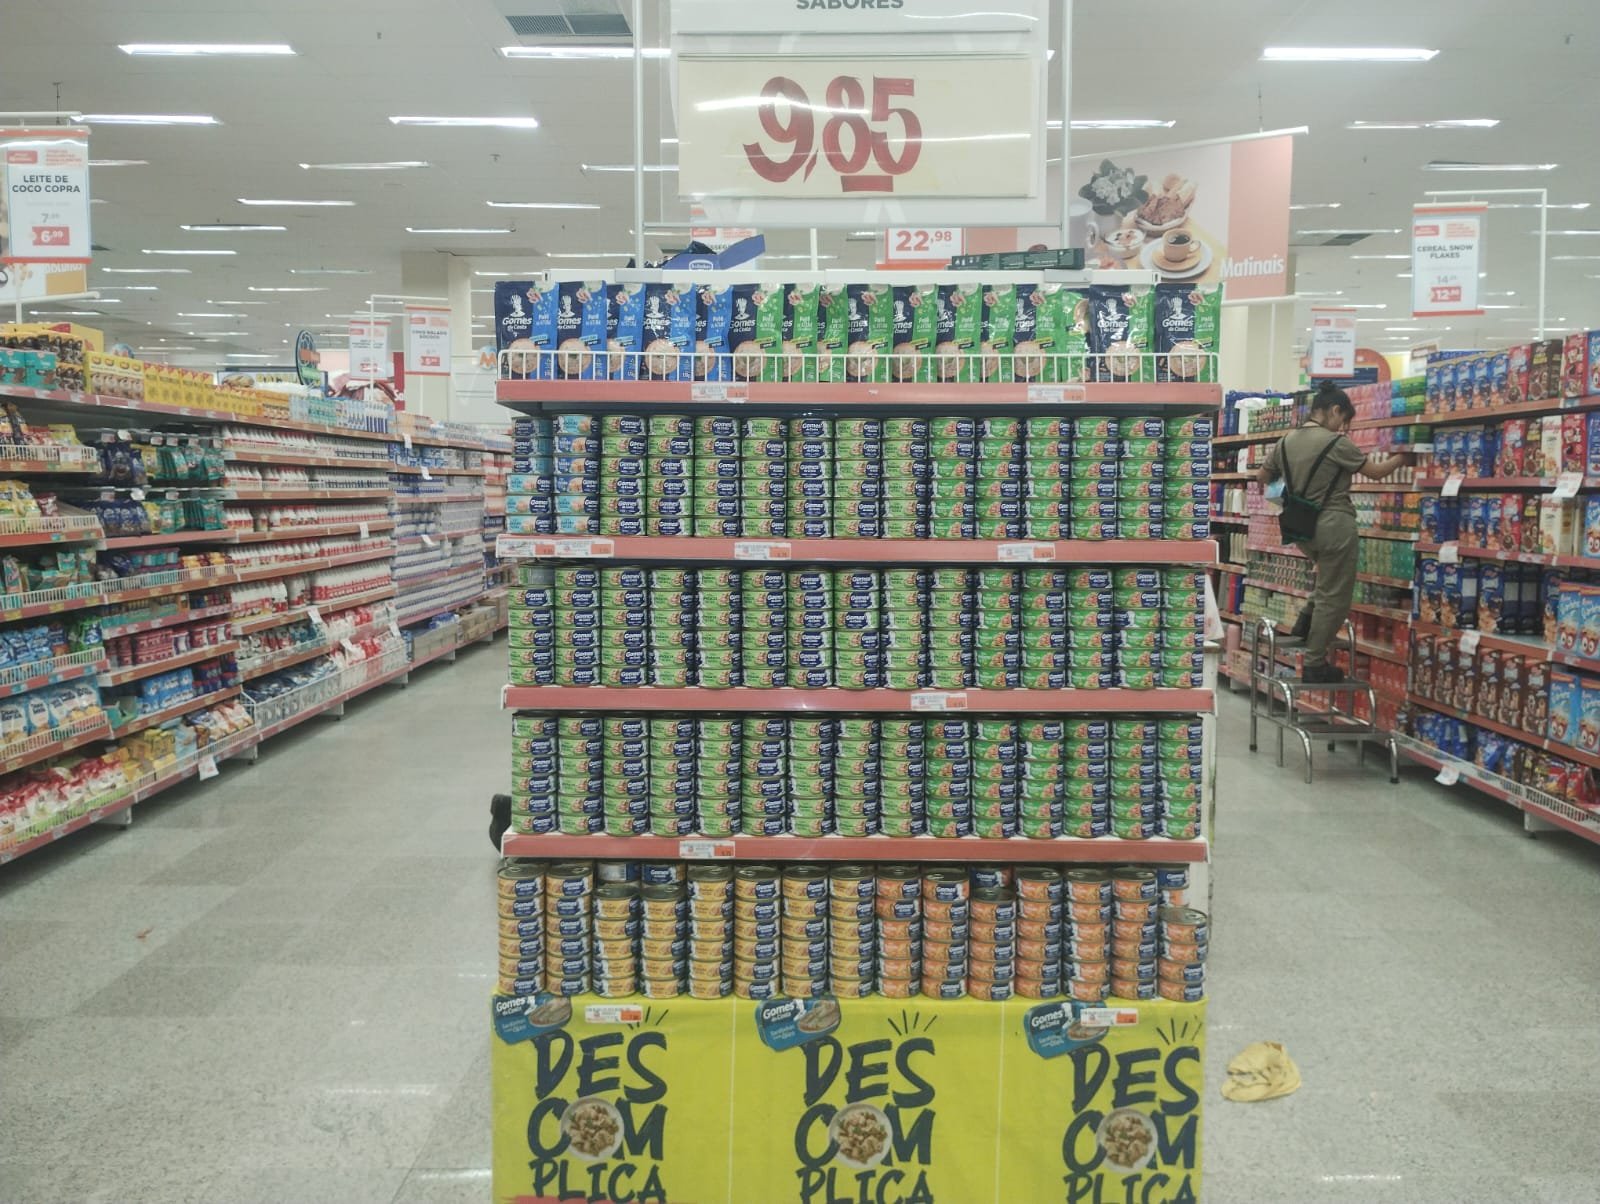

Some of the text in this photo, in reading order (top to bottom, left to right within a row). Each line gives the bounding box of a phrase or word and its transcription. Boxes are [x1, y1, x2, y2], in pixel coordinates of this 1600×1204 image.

[743, 75, 922, 184] 9,85
[12, 184, 81, 193] COCO COPRA
[23, 175, 69, 183] LEITE DE
[895, 230, 952, 252] 22,98
[1417, 245, 1447, 253] CEREAL
[1220, 253, 1285, 278] Matinais
[502, 317, 533, 326] Gomes
[1162, 318, 1194, 327] Gomes
[496, 997, 526, 1012] Gomes
[763, 1002, 795, 1020] Gomes
[1031, 1009, 1064, 1027] Gomes
[530, 1029, 668, 1104] DES
[799, 1034, 936, 1109] DES
[1068, 1044, 1200, 1116] DES
[528, 1159, 667, 1204] PLICA
[796, 1167, 934, 1204] PLICA
[1063, 1172, 1199, 1204] PLICA
